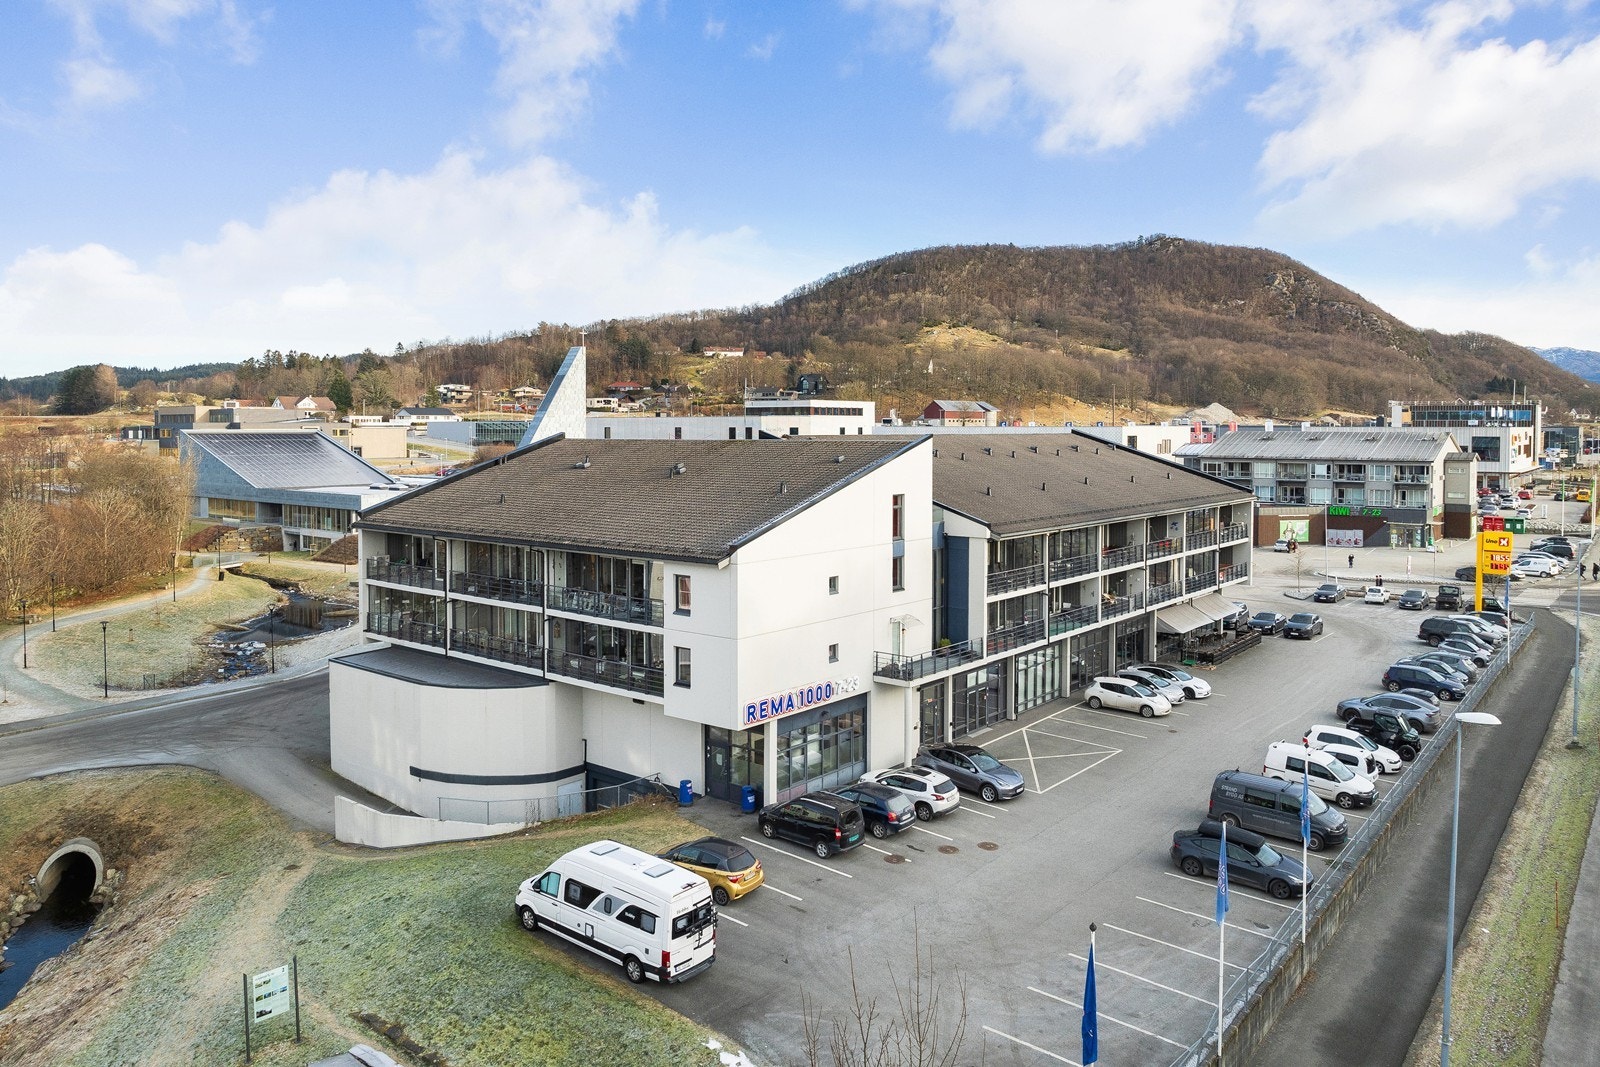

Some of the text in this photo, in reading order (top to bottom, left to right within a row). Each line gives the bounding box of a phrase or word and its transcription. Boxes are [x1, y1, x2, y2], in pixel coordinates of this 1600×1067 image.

[1329, 505, 1350, 516] KIWI
[745, 692, 796, 723] REMA
[798, 681, 832, 708] 1000
